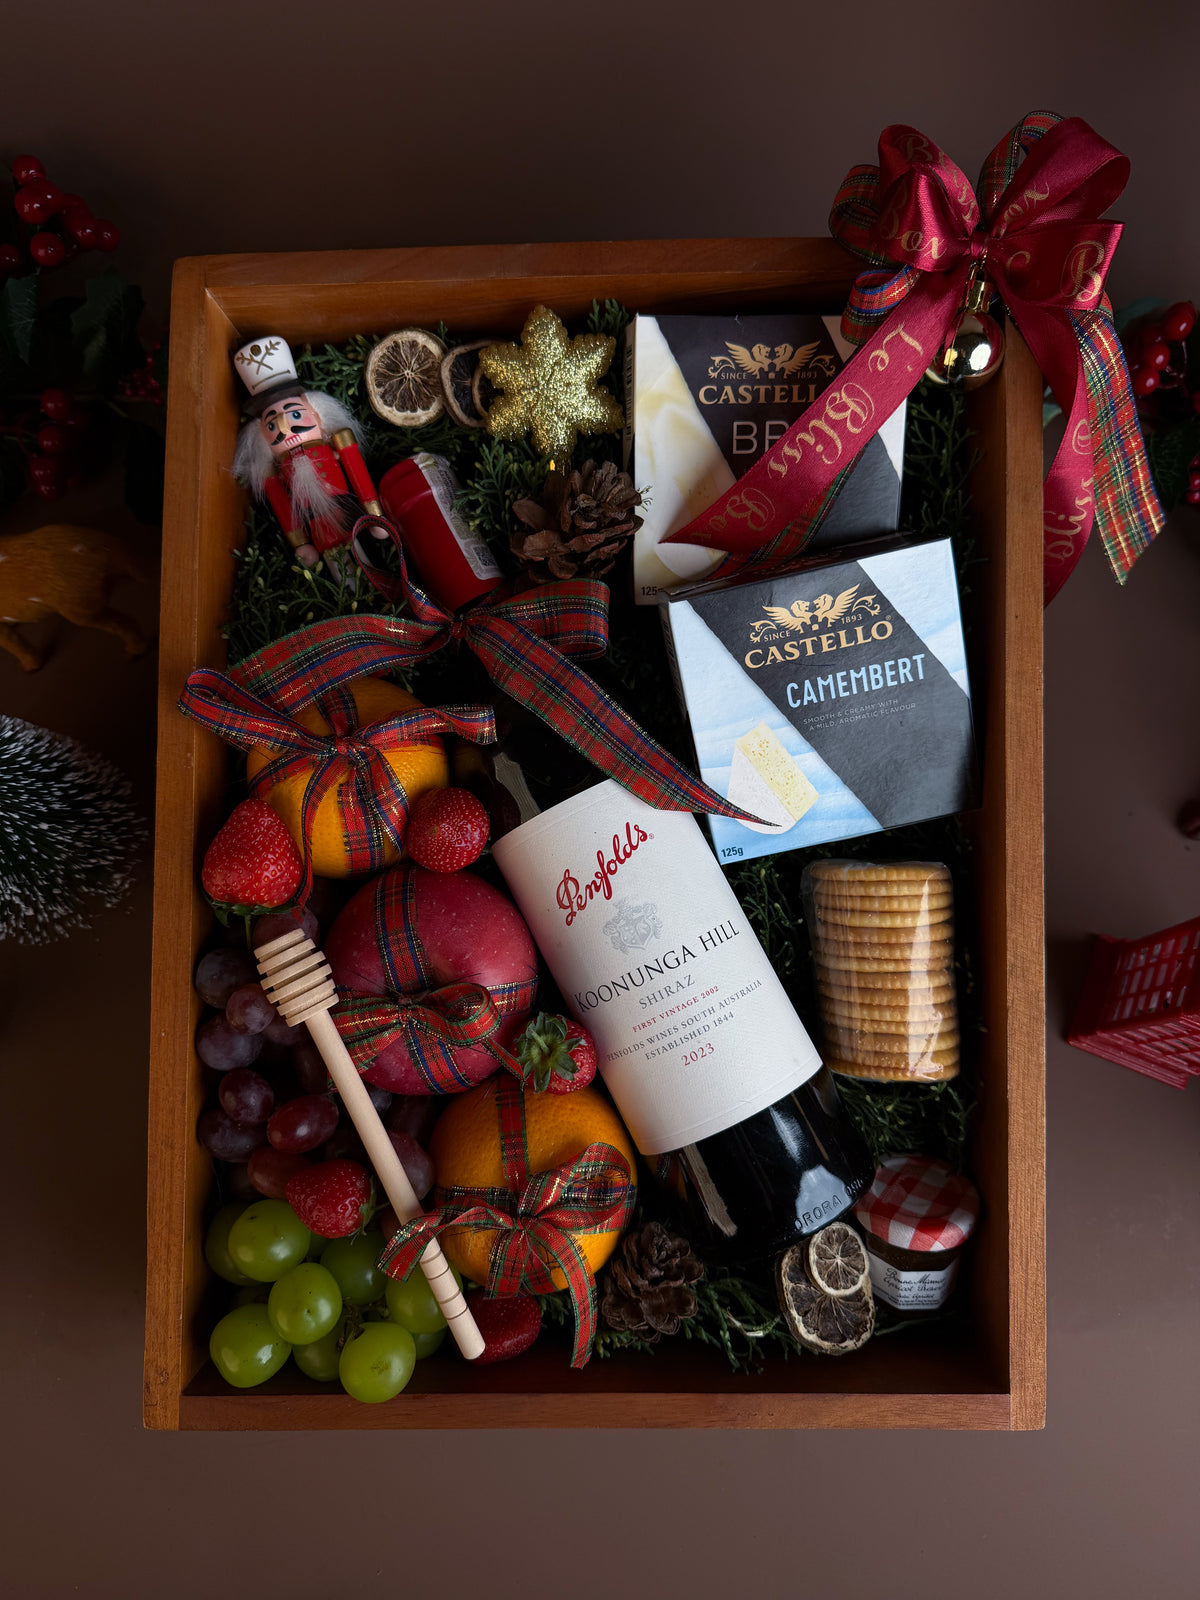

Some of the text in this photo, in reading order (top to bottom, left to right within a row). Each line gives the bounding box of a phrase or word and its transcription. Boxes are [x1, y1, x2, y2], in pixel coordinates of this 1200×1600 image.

[720, 370, 818, 380] SINCE 1893
[698, 384, 817, 405] CASTELL
[732, 420, 790, 455] BR
[767, 382, 875, 479] Bliss
[744, 620, 893, 669] CASTELLO
[763, 613, 863, 642] SINCE 1893
[786, 653, 926, 709] CAMEMBERT
[803, 713, 835, 725] SMOOTH
[844, 703, 876, 715] CREAMY
[878, 699, 899, 708] WITH
[839, 710, 878, 724] AROMATIC
[880, 702, 916, 715] FLAVOUR
[721, 846, 744, 858] 125g
[556, 821, 649, 926] Penfolds
[574, 920, 740, 1013] KOONUNGA HILL
[632, 985, 720, 1033] FIRST VINTAGE 2002
[638, 974, 695, 1010] SHIRAZ
[606, 979, 763, 1062] PENFOLDS WINES SOUTH AUSTRALIA
[645, 1011, 735, 1061] ESTABLISHED 1844
[681, 1042, 715, 1066] 2023
[793, 1194, 843, 1231] ORORA
